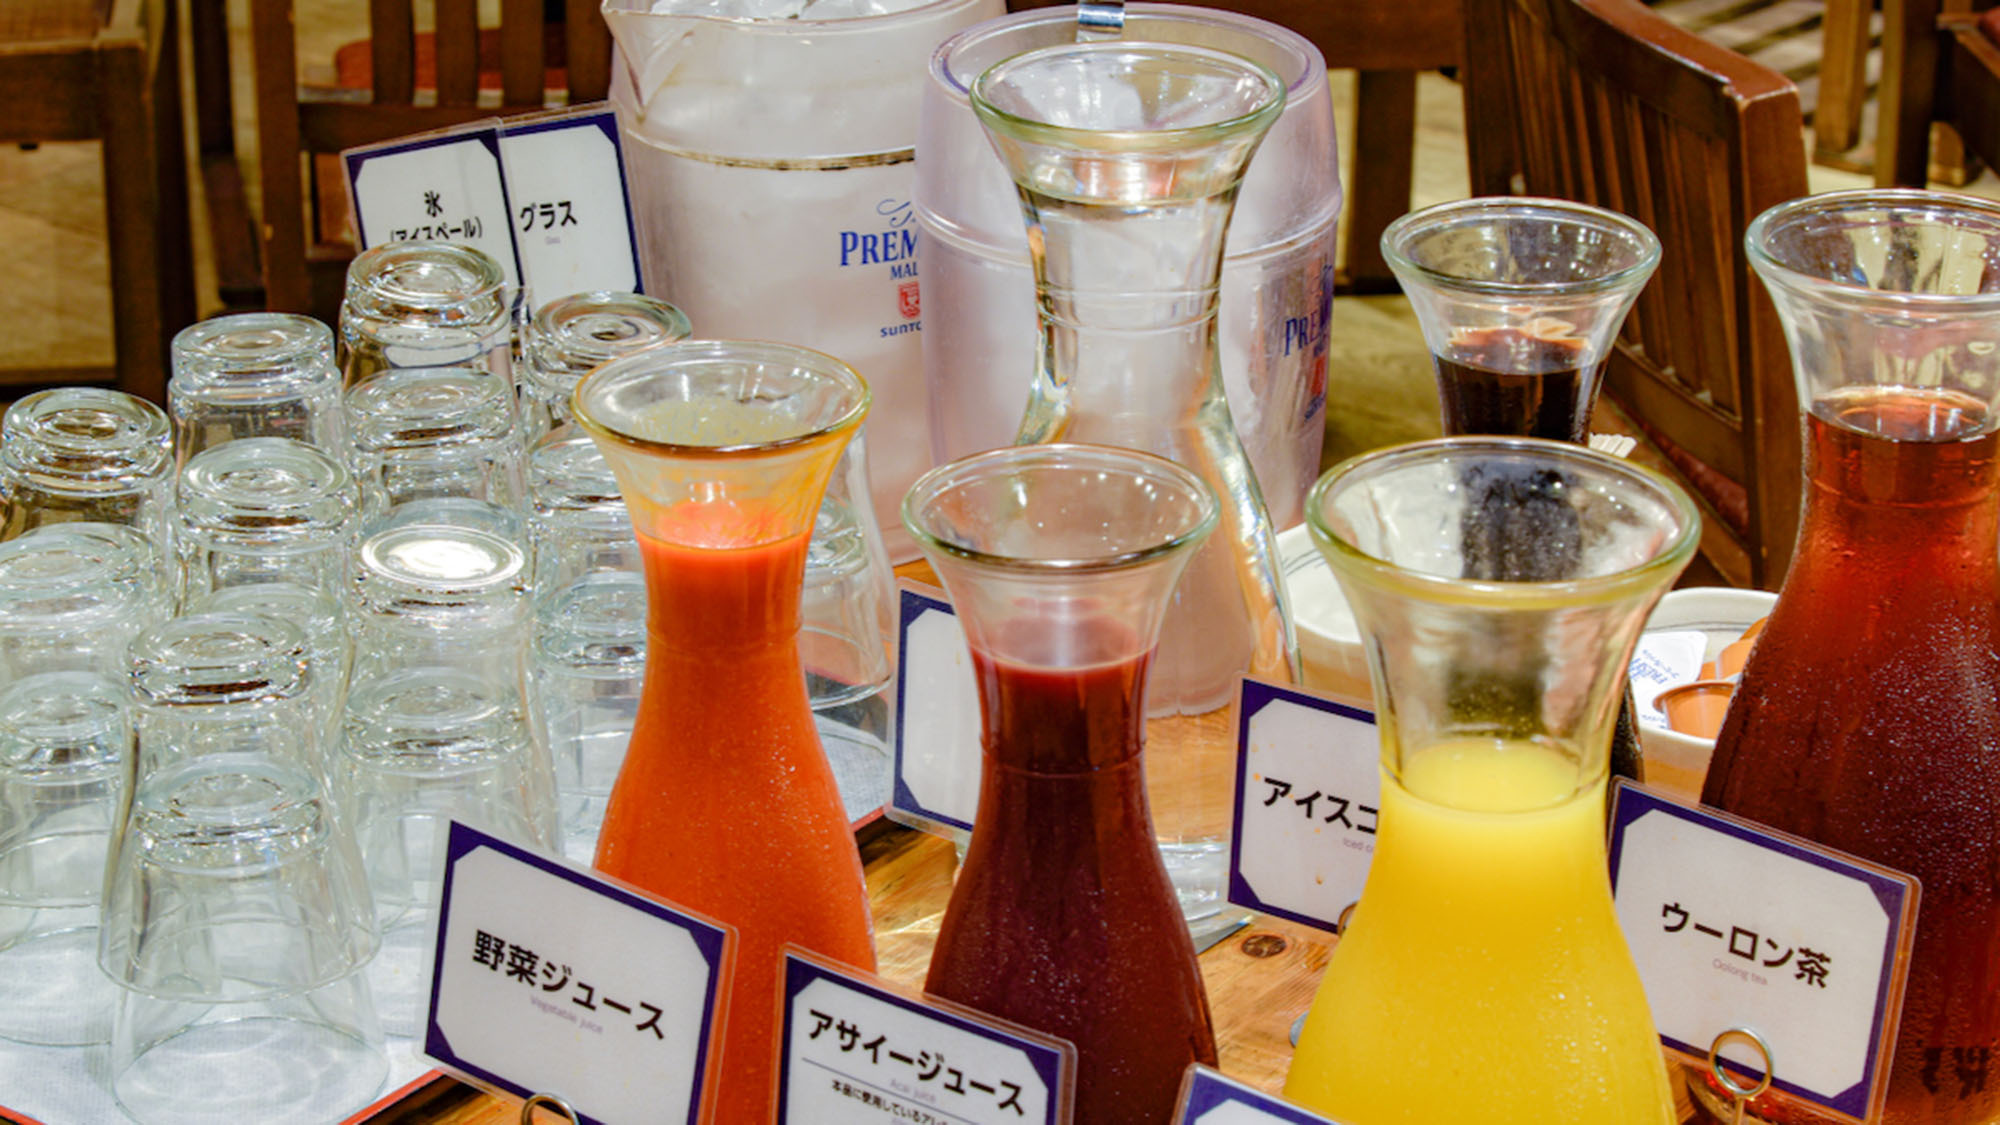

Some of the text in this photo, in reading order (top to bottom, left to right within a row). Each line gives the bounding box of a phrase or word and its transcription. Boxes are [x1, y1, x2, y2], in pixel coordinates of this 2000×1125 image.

[424, 190, 444, 218] 氷
[520, 200, 578, 232] グラス
[1284, 308, 1326, 357] PRE
[1263, 776, 1379, 835] アイスコ
[1661, 902, 1832, 989] ウーロン茶
[472, 929, 665, 1041] 野菜ジュース
[809, 1008, 1025, 1117] アサイージュース
